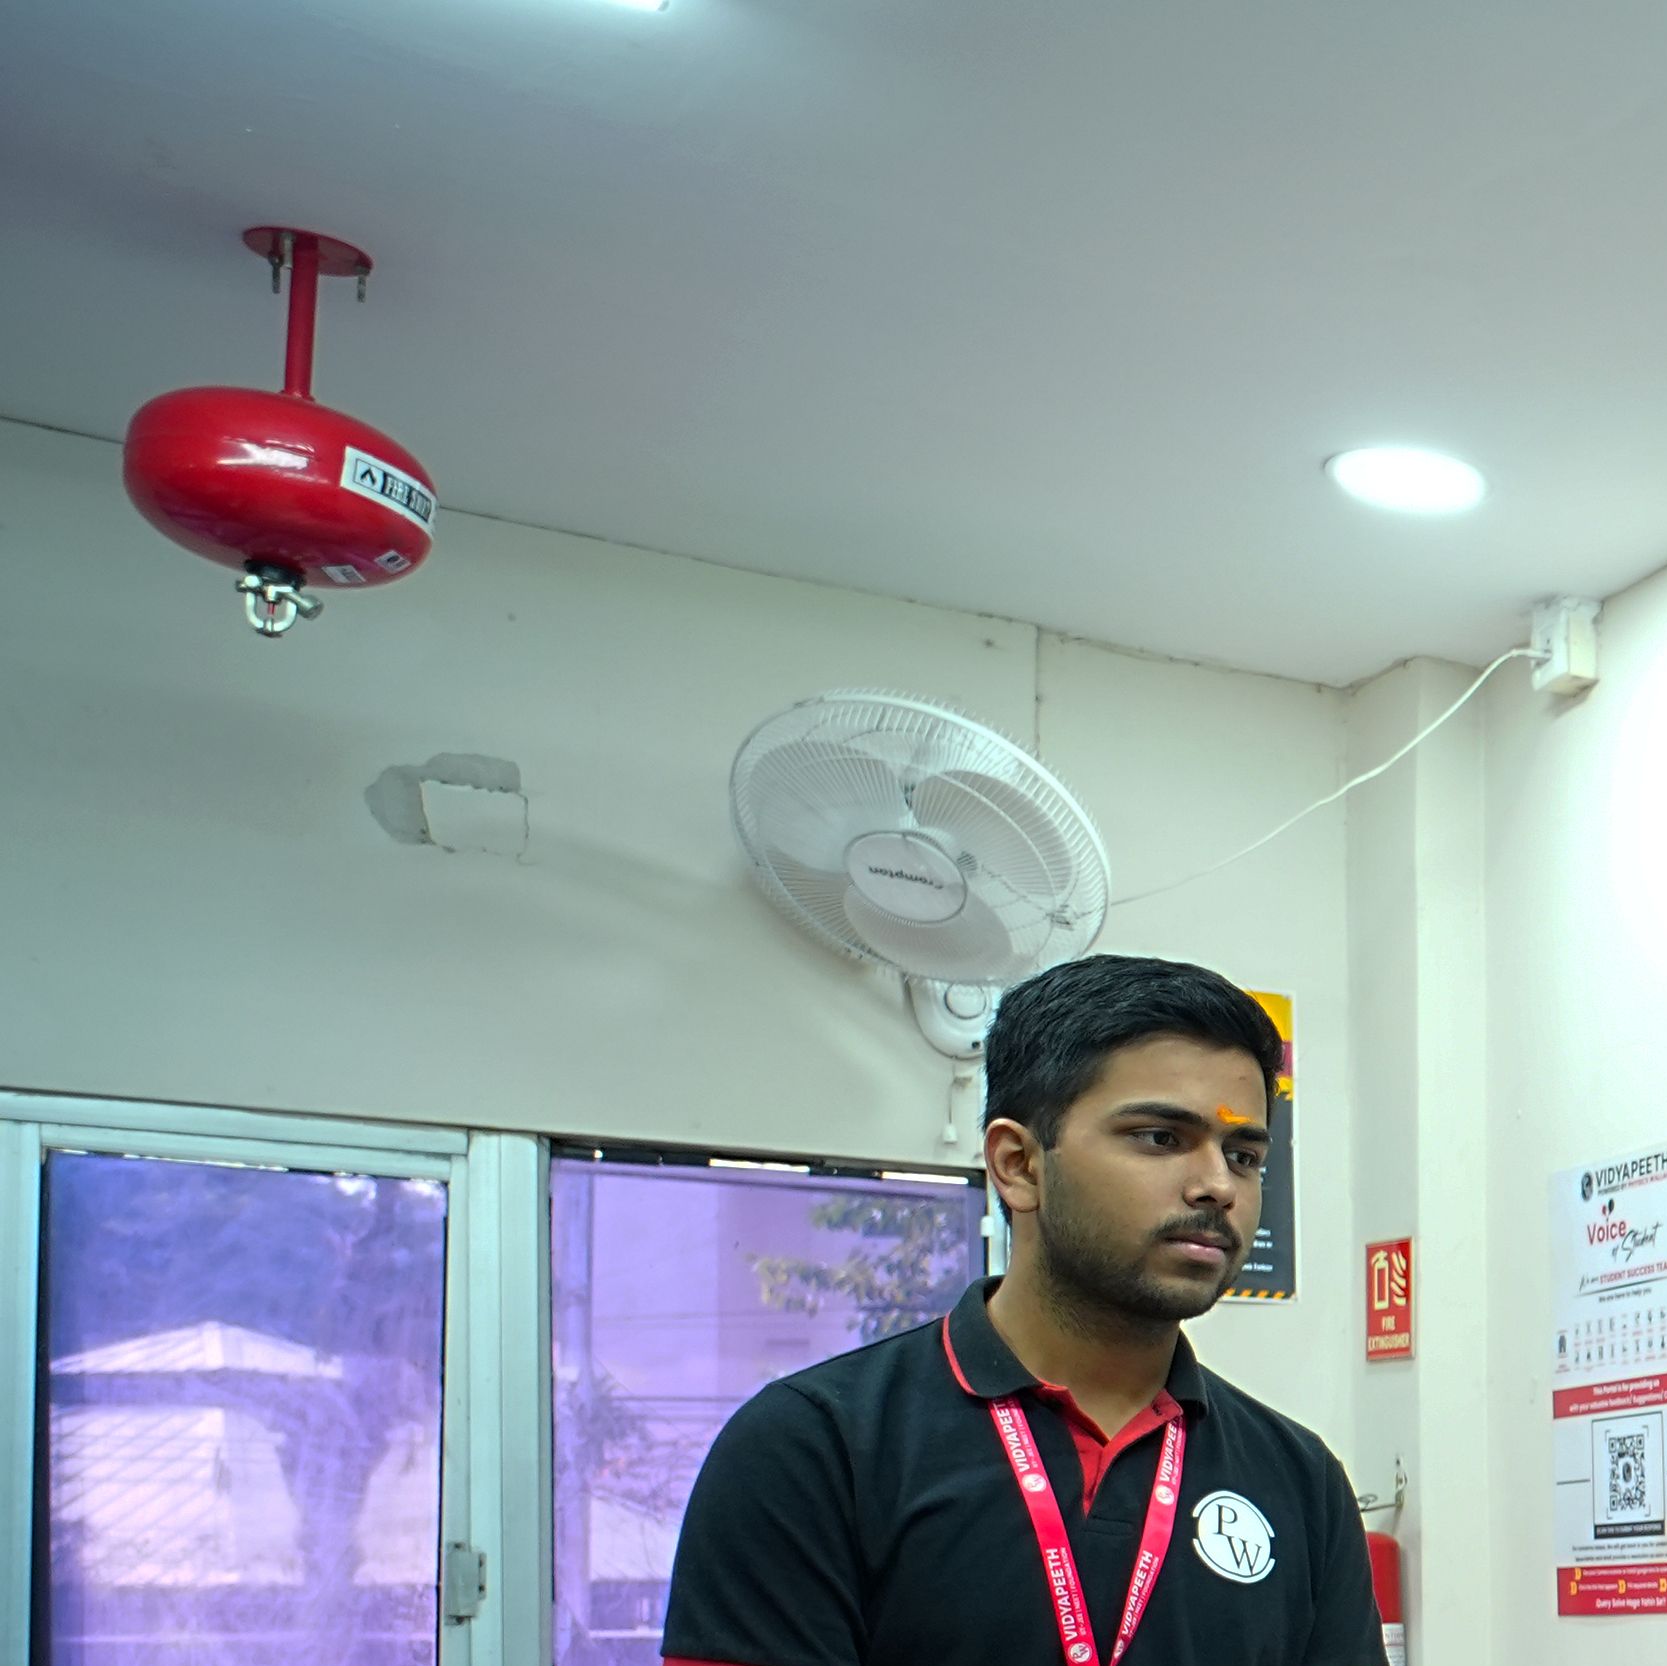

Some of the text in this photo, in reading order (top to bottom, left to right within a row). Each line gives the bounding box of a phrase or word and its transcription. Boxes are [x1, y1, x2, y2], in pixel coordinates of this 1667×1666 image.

[1587, 1221, 1626, 1245] Voice
[1621, 1221, 1663, 1262] Student
[1600, 1270, 1626, 1284] STUDENT
[1627, 1265, 1655, 1279] SUCCESS
[1382, 1316, 1395, 1331] FIRE
[1213, 1504, 1261, 1575] PW
[1046, 1549, 1078, 1641] VIDYAPEETH
[1122, 1550, 1153, 1635] VIDYAPEETH
